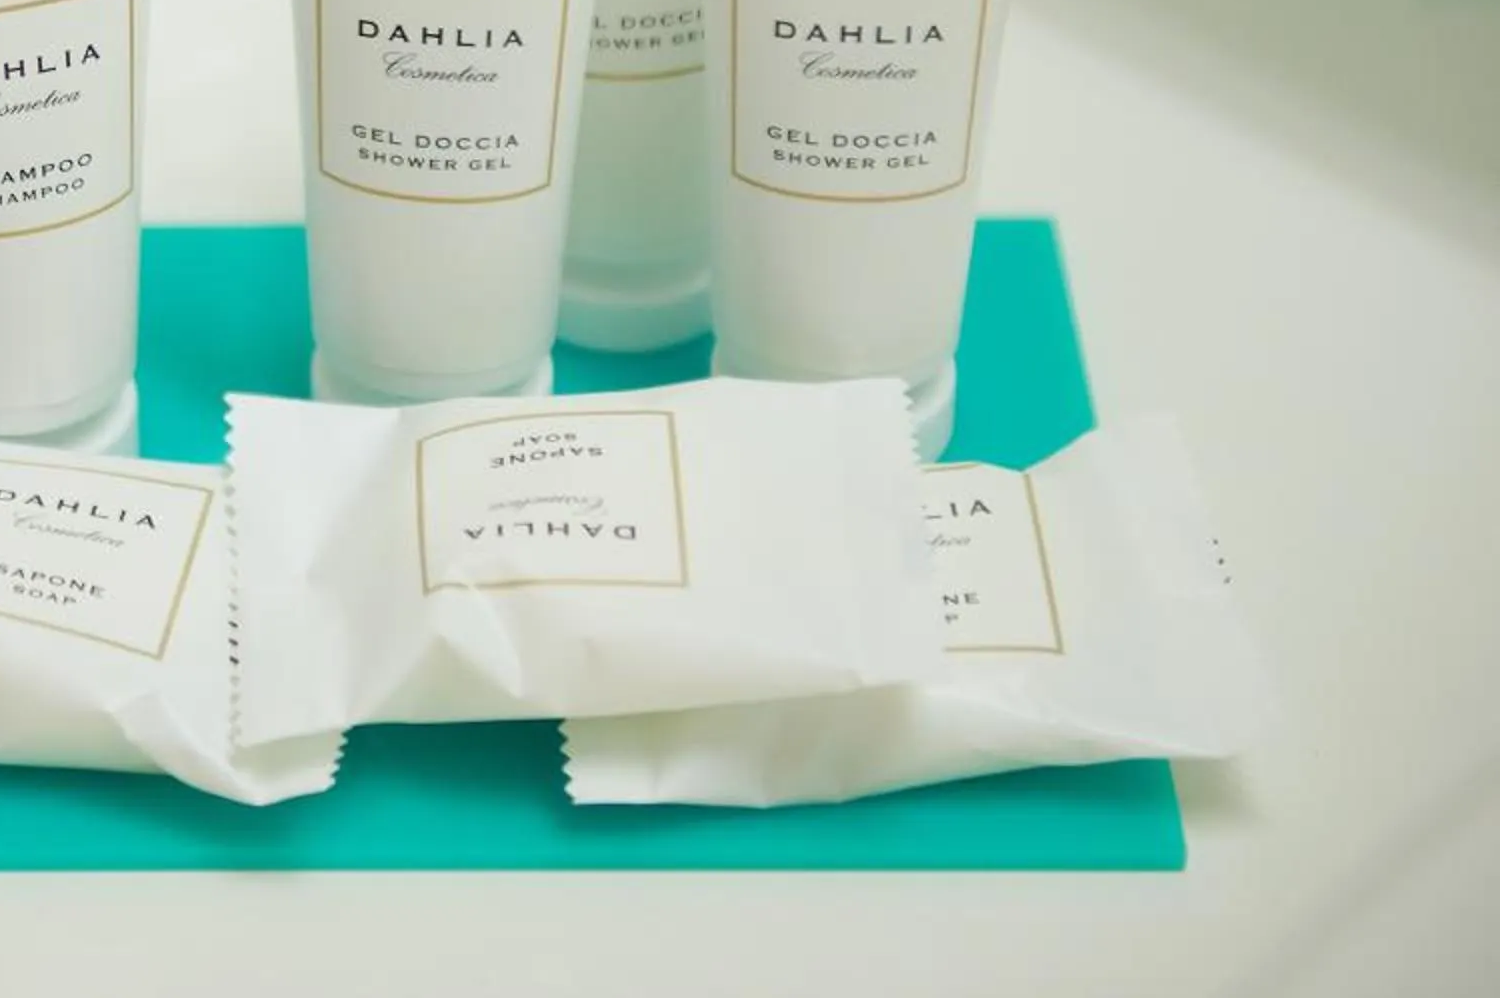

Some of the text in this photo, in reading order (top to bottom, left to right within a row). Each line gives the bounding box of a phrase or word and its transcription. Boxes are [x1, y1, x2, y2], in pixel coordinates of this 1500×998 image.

[620, 8, 702, 30] DOCCI
[357, 18, 524, 49] DAHLIA
[773, 19, 944, 45] DAHLIA
[382, 51, 499, 83] Cosmetica
[799, 51, 918, 80] Cosmetica
[351, 124, 519, 151] GEL DOCCIA
[766, 125, 937, 148] GEL DOCCIA
[358, 147, 511, 172] SHOWER GEL
[772, 149, 929, 170] SHOWER GEL
[512, 432, 578, 448] SOAP
[490, 446, 604, 469] SAPONE
[463, 521, 637, 541] DAHLIA
[12, 584, 78, 606] SOAP
